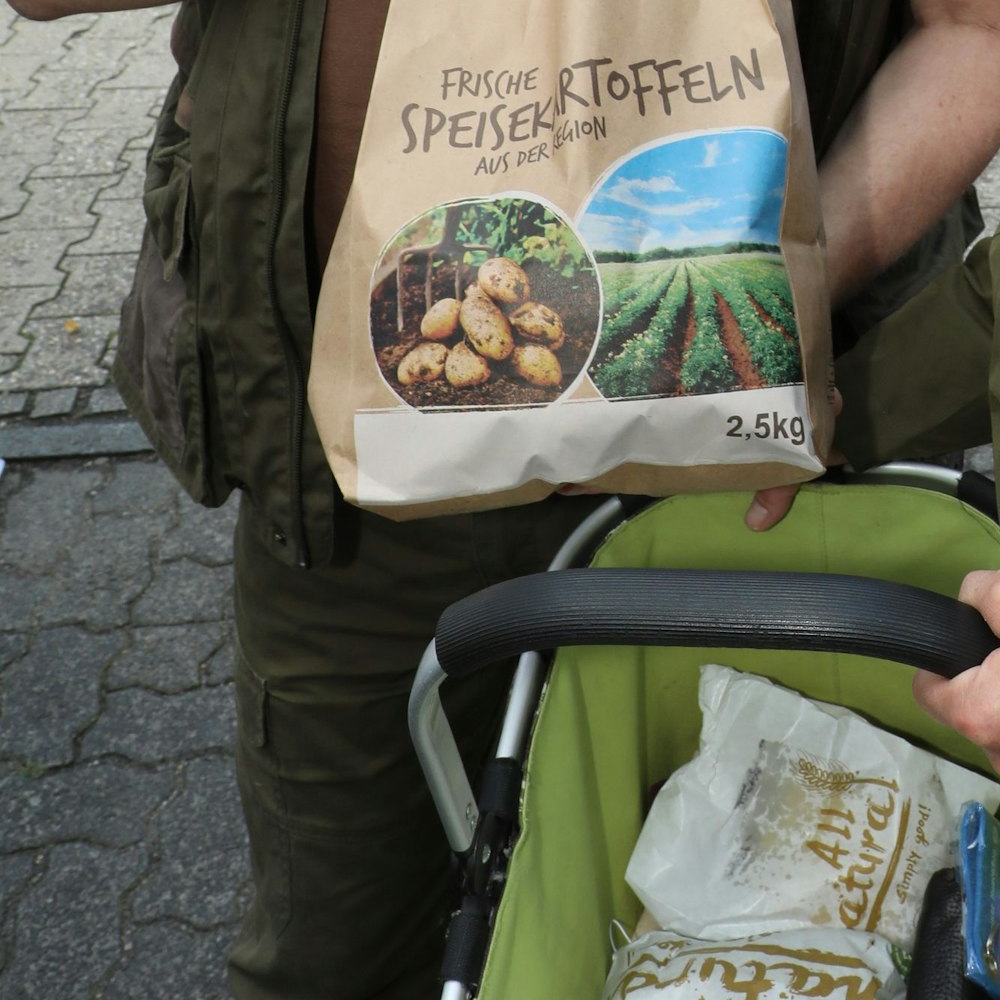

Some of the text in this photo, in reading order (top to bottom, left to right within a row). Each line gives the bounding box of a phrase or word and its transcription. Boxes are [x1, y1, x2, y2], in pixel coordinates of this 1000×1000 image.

[440, 66, 540, 101] FRISCHE
[474, 154, 510, 176] AUS
[516, 142, 550, 168] DER
[725, 411, 806, 446] 2,5kg
[838, 778, 900, 929] atural
